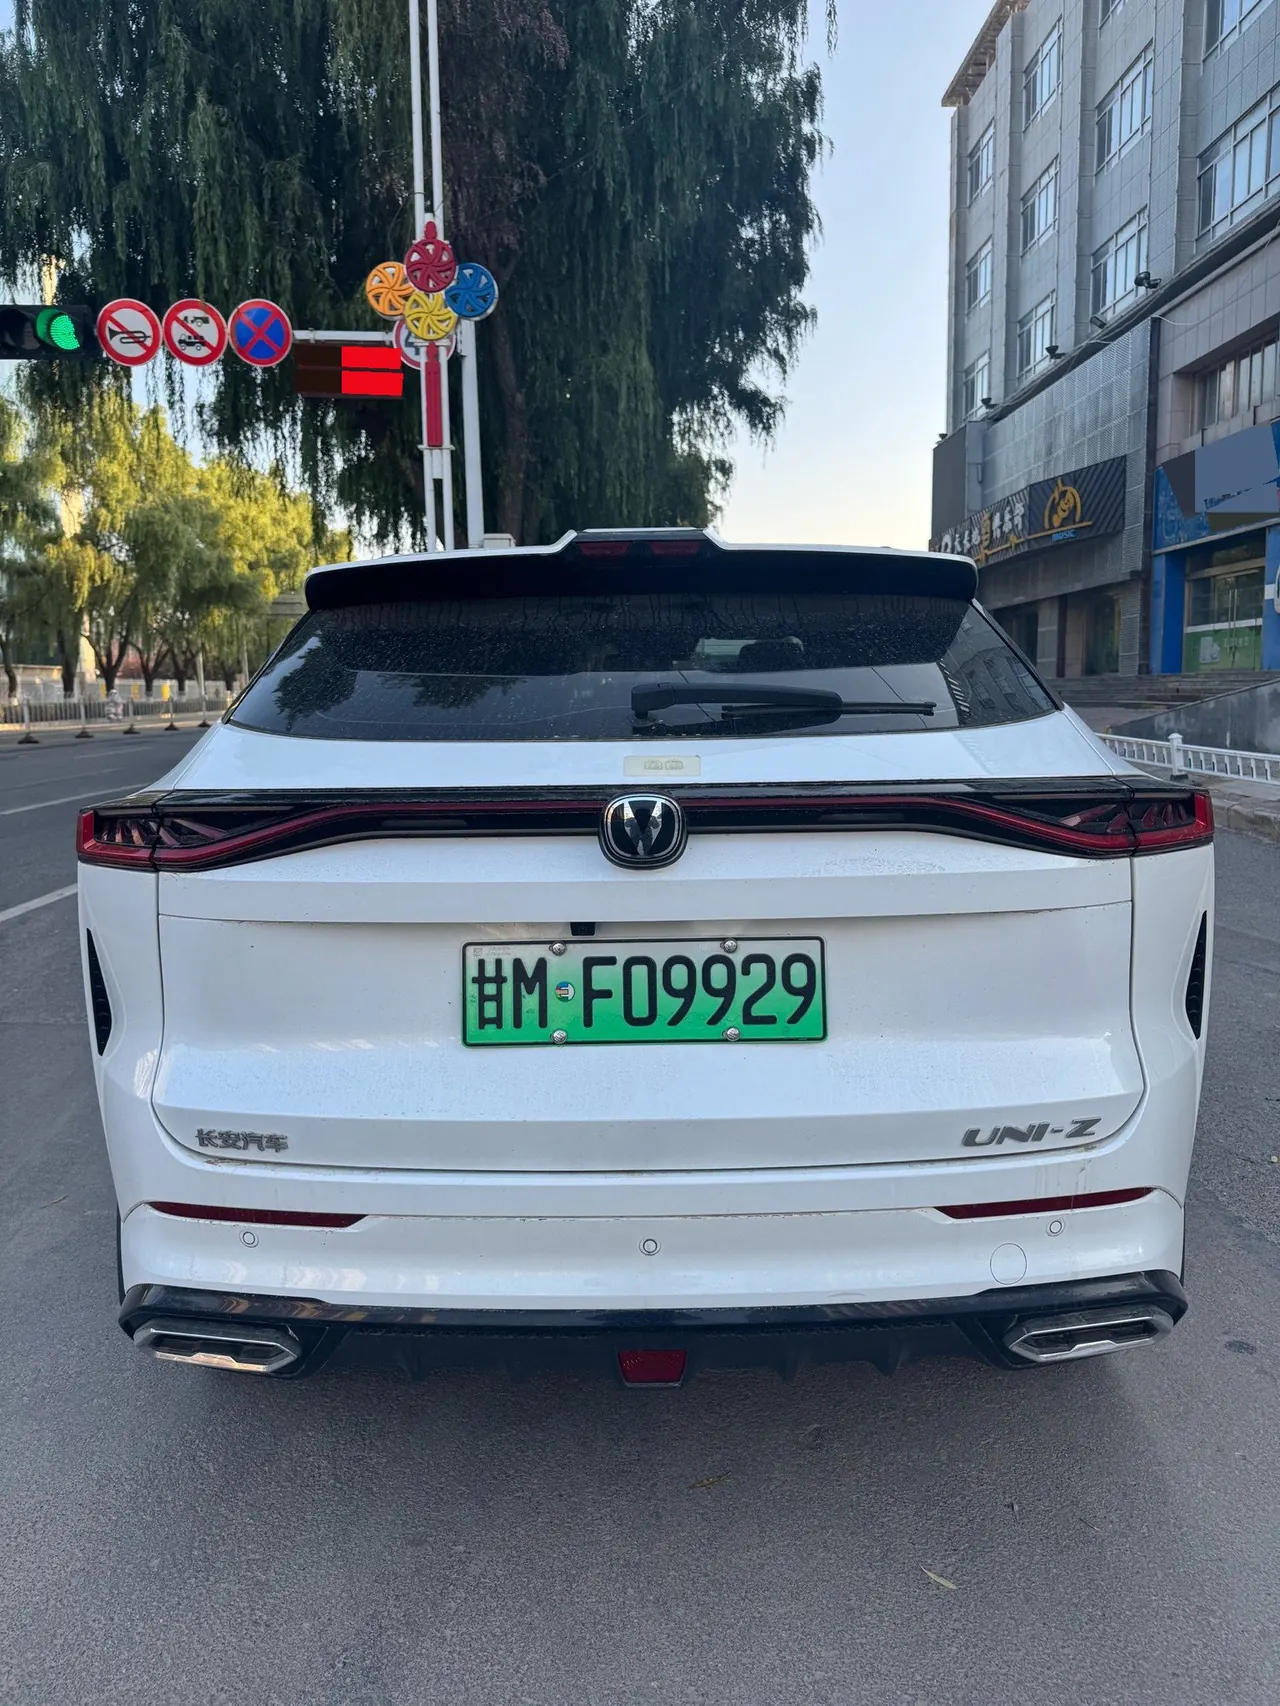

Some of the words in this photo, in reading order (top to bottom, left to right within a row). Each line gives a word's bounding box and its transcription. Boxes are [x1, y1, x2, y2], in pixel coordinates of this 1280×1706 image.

[471, 956, 548, 1030] 甘M
[582, 952, 817, 1029] F09929
[195, 1128, 288, 1153] 长安汽车
[962, 1116, 1102, 1147] UNI-Z
